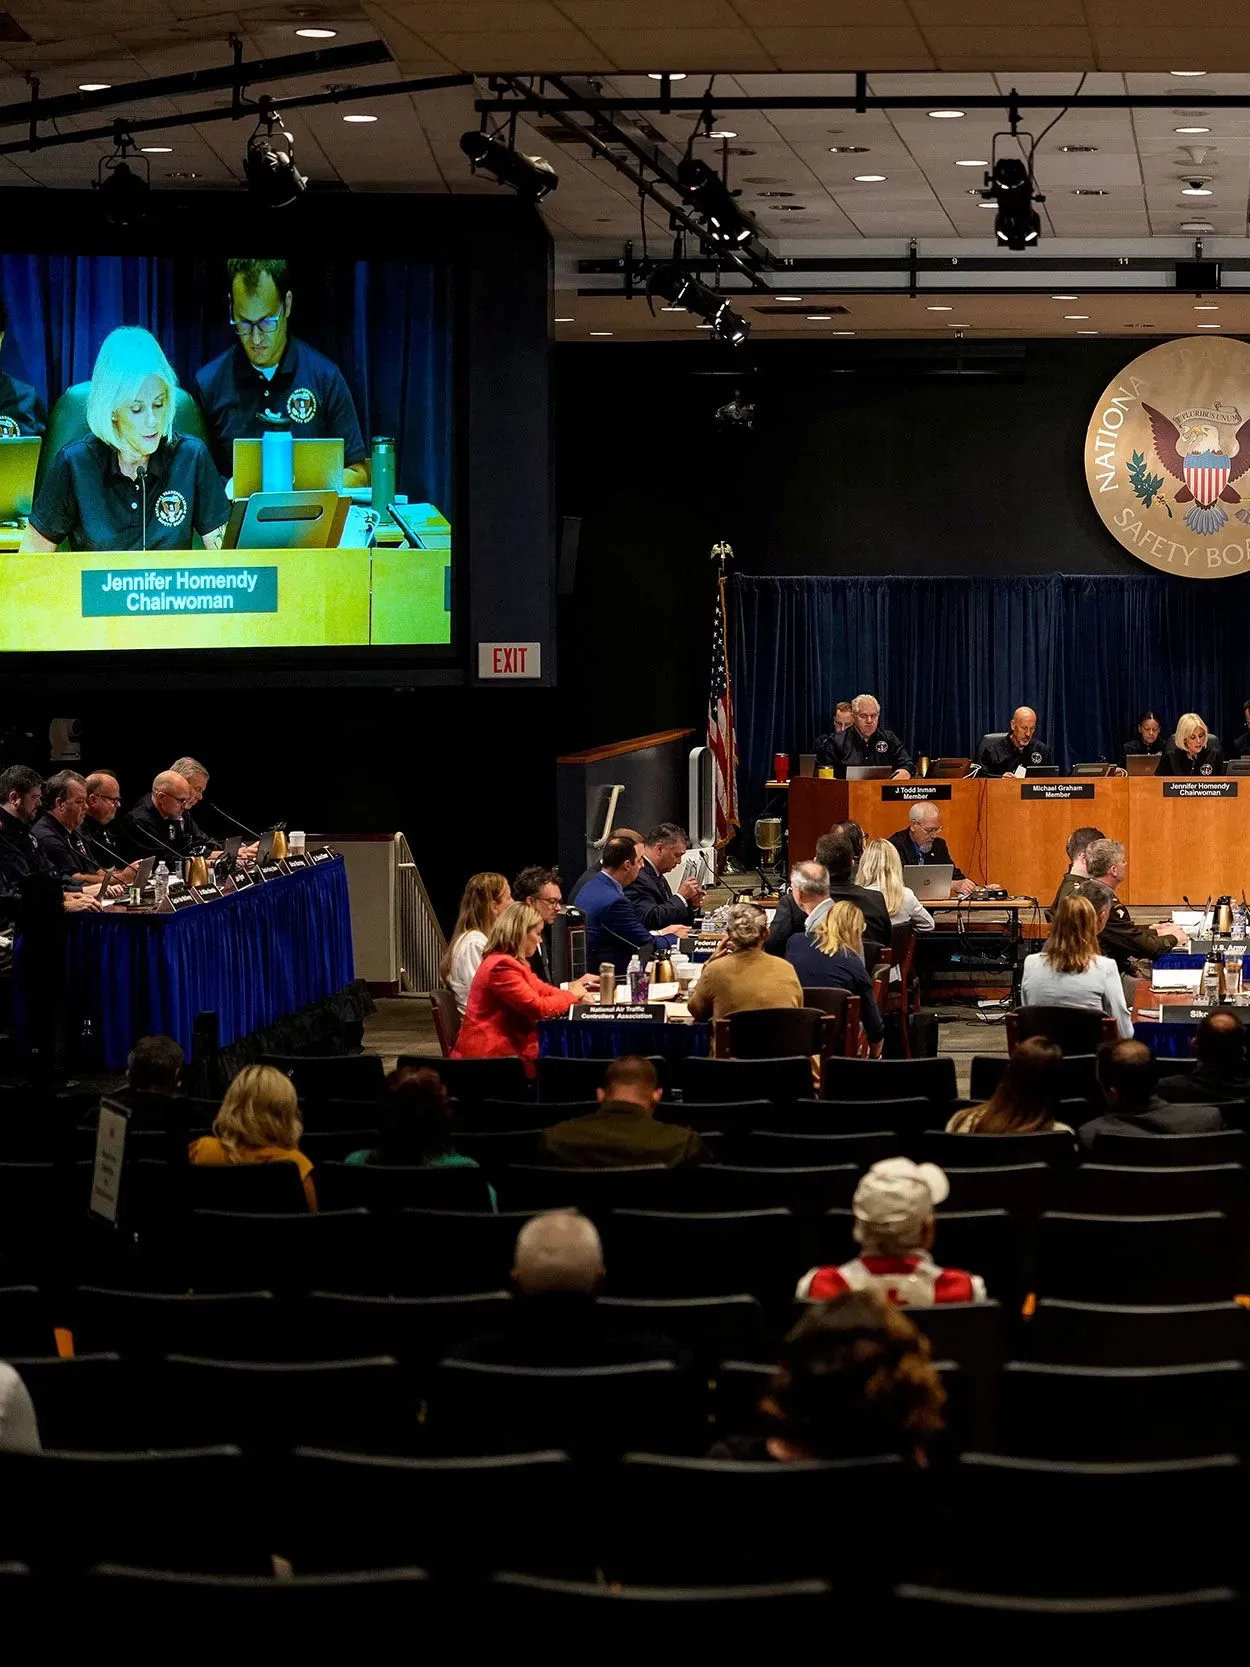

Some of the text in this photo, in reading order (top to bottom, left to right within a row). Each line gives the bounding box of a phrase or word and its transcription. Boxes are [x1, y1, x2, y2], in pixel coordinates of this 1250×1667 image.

[784, 258, 795, 266] 11
[1118, 257, 1130, 265] 11
[1095, 375, 1148, 494] NATIONA
[1113, 507, 1198, 567] SAFETY
[101, 570, 258, 593] Jennifer Homendy
[126, 592, 234, 612] Chairwoman
[493, 647, 528, 673] EXIT
[900, 786, 916, 794] Todd
[1170, 782, 1230, 791] Jennifer Homendy
[1227, 944, 1248, 952] Army
